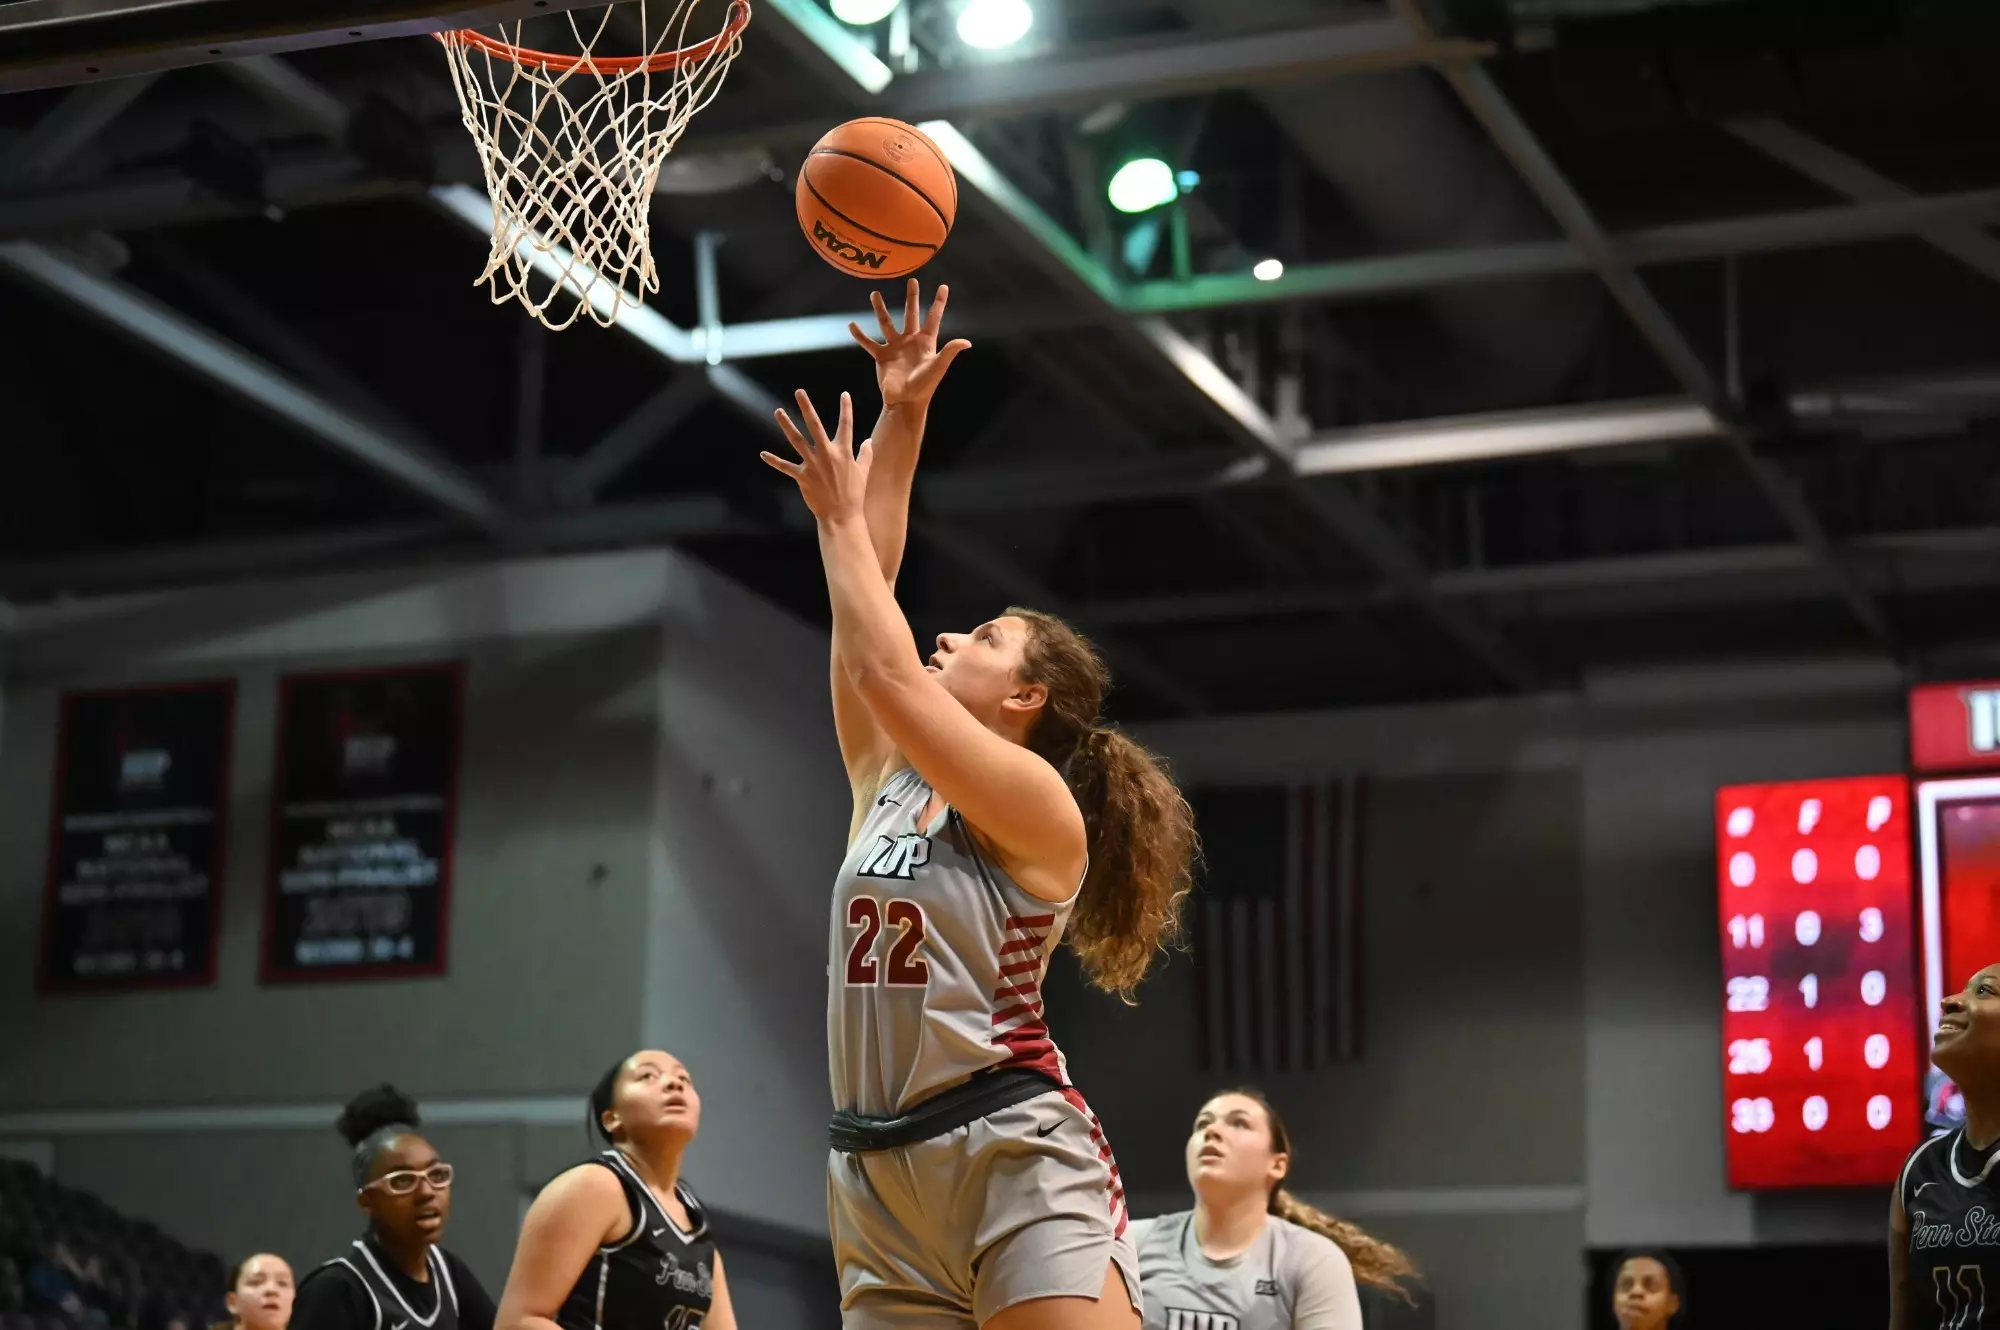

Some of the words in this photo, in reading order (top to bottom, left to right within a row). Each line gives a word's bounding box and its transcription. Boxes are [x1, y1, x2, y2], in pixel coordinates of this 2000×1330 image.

[813, 219, 888, 269] NCAA
[857, 832, 933, 881] IUP
[1729, 852, 1756, 888] 0
[1792, 849, 1818, 884] 0
[1855, 845, 1881, 881] 0
[845, 895, 930, 987] 22
[1728, 914, 1765, 949] 11
[1795, 911, 1821, 946] 0
[1858, 908, 1884, 943] 3
[1727, 976, 1770, 1012] 22
[1799, 974, 1818, 1008] 1
[1860, 971, 1886, 1006] 0
[1728, 1038, 1772, 1074] 25
[1803, 1037, 1823, 1070] 1
[1864, 1034, 1890, 1069] 0
[1802, 1096, 1828, 1131] 0
[1867, 1095, 1892, 1130] 0
[1912, 1210, 1954, 1250] Penn
[1932, 1264, 1986, 1330] 11
